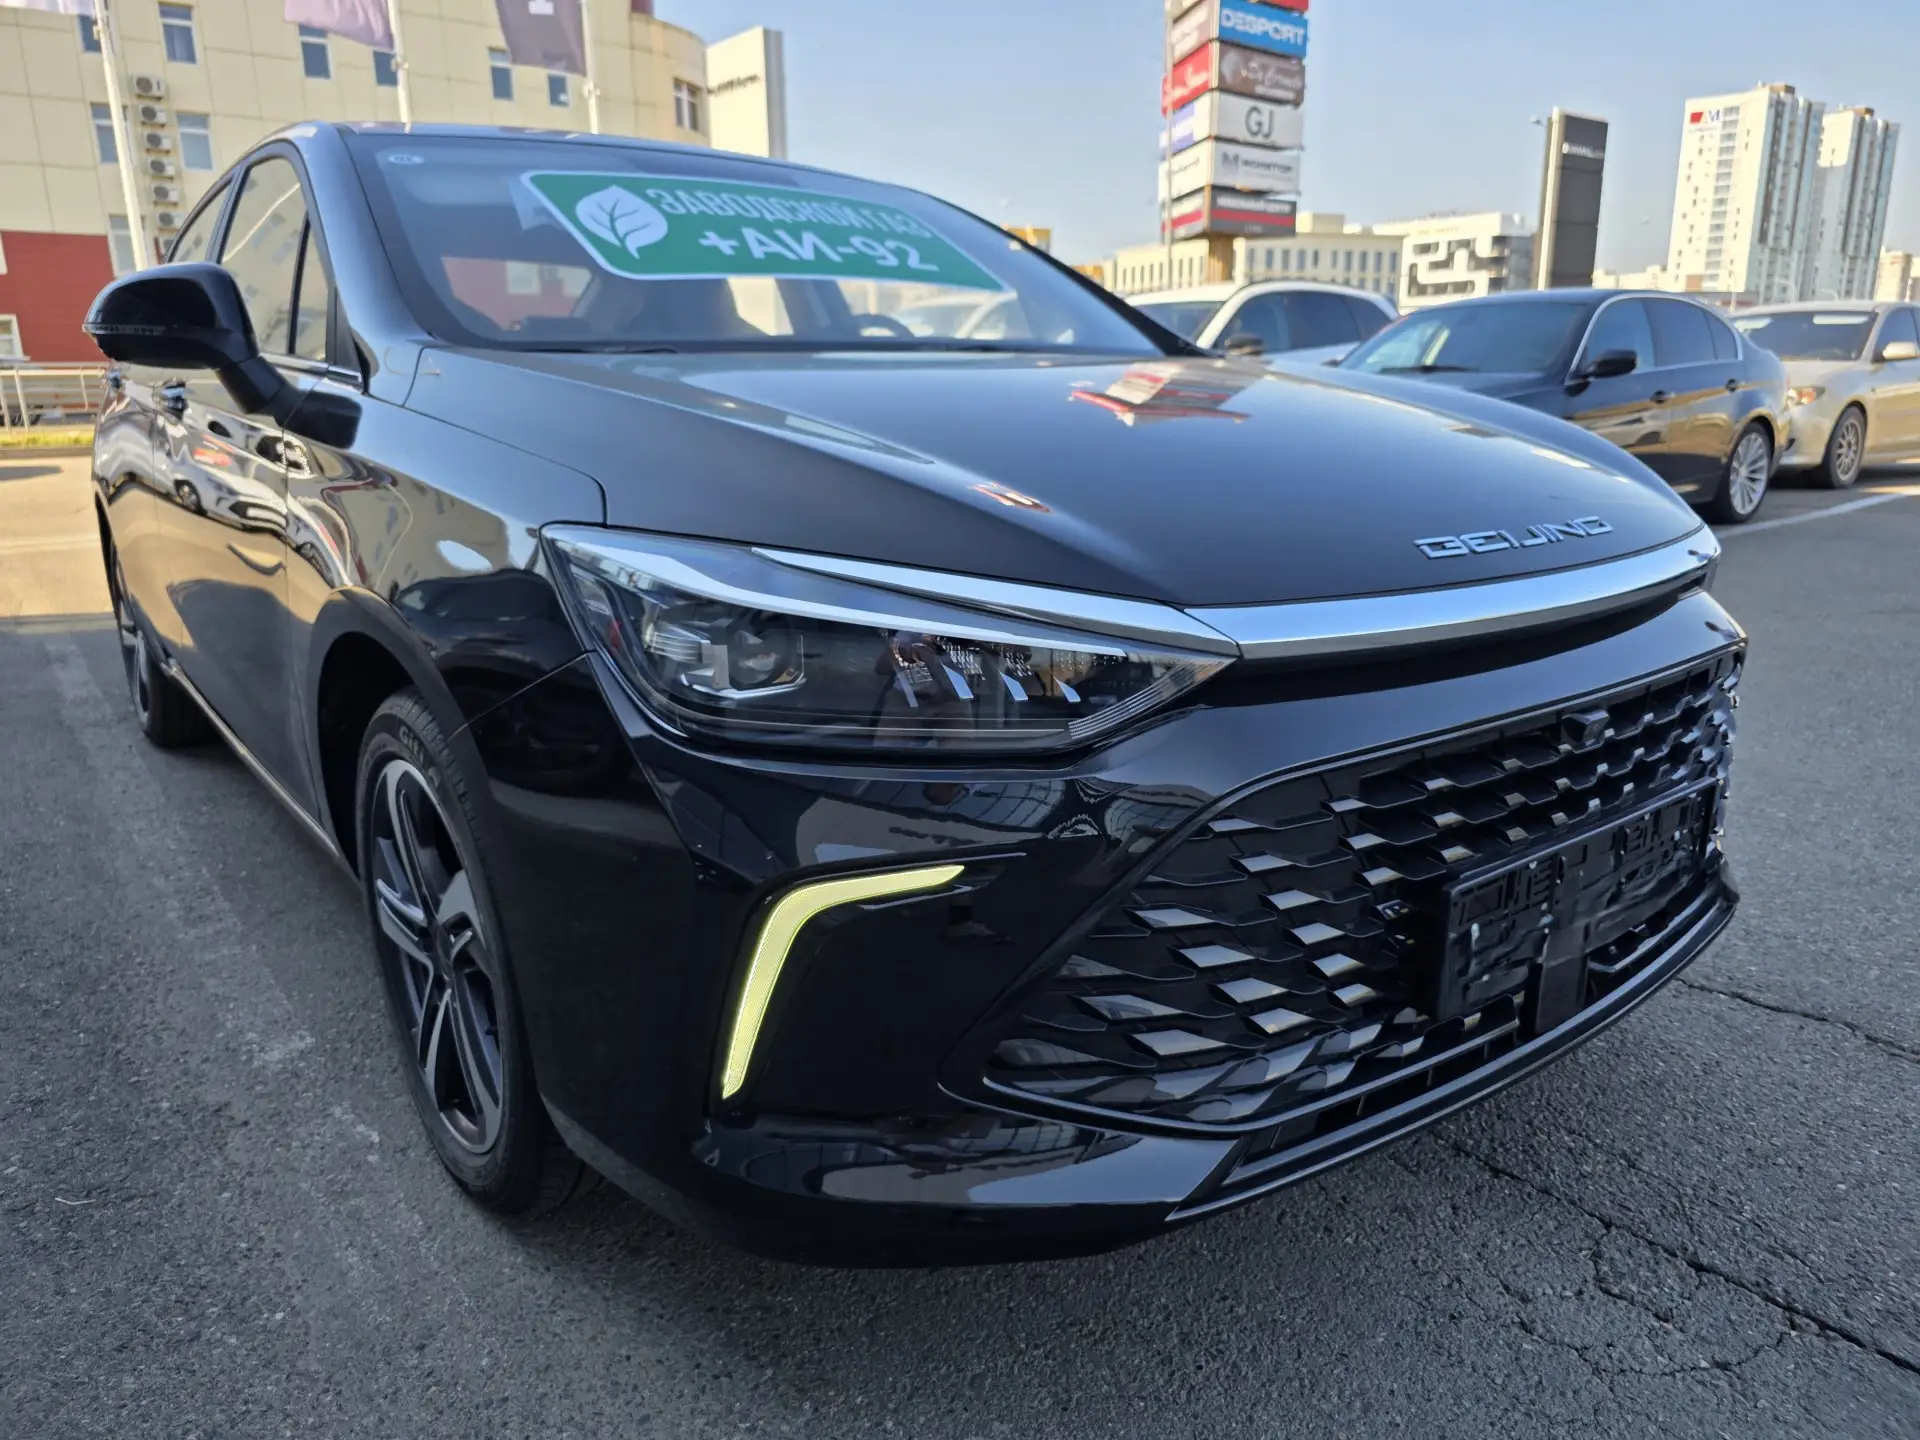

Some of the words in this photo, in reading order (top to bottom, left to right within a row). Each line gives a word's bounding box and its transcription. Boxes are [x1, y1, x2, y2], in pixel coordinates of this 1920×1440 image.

[1245, 105, 1275, 140] GJ
[645, 188, 874, 231] ЗАВОДСКОЙ
[858, 206, 933, 239] ГАЗ
[698, 226, 940, 272] +АИ-92
[1413, 515, 1614, 560] BEIJING
